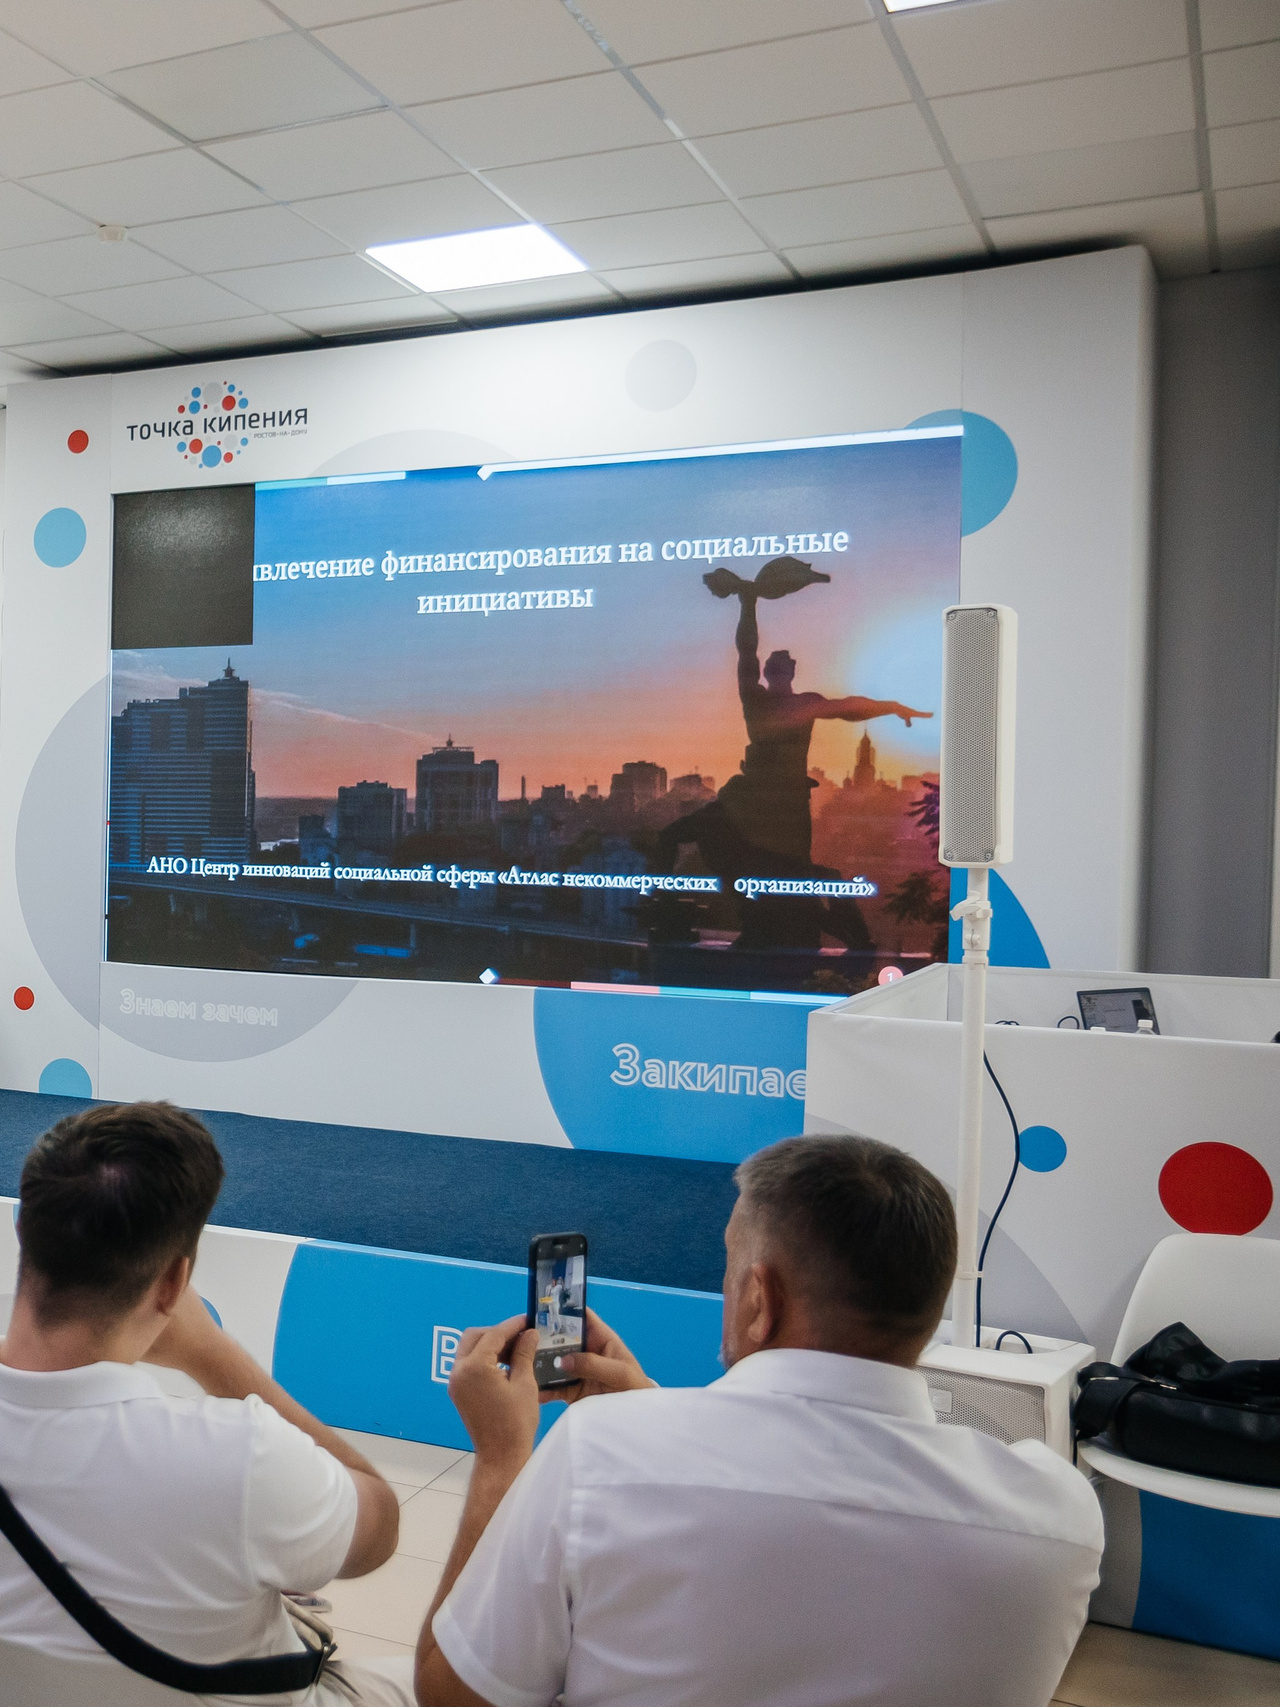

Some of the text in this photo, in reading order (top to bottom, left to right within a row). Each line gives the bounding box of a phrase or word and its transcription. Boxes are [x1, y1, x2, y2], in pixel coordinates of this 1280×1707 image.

[126, 408, 308, 441] точка кипения
[381, 543, 612, 581] финансирования
[618, 541, 654, 564] на
[661, 530, 849, 565] социальные
[417, 588, 594, 617] инициативы
[147, 856, 875, 899] АНО Центр инноваций социальной сферы «Атлас некоммерческих организаций»
[886, 972, 893, 982] 1
[119, 988, 278, 1027] Знаем зачем
